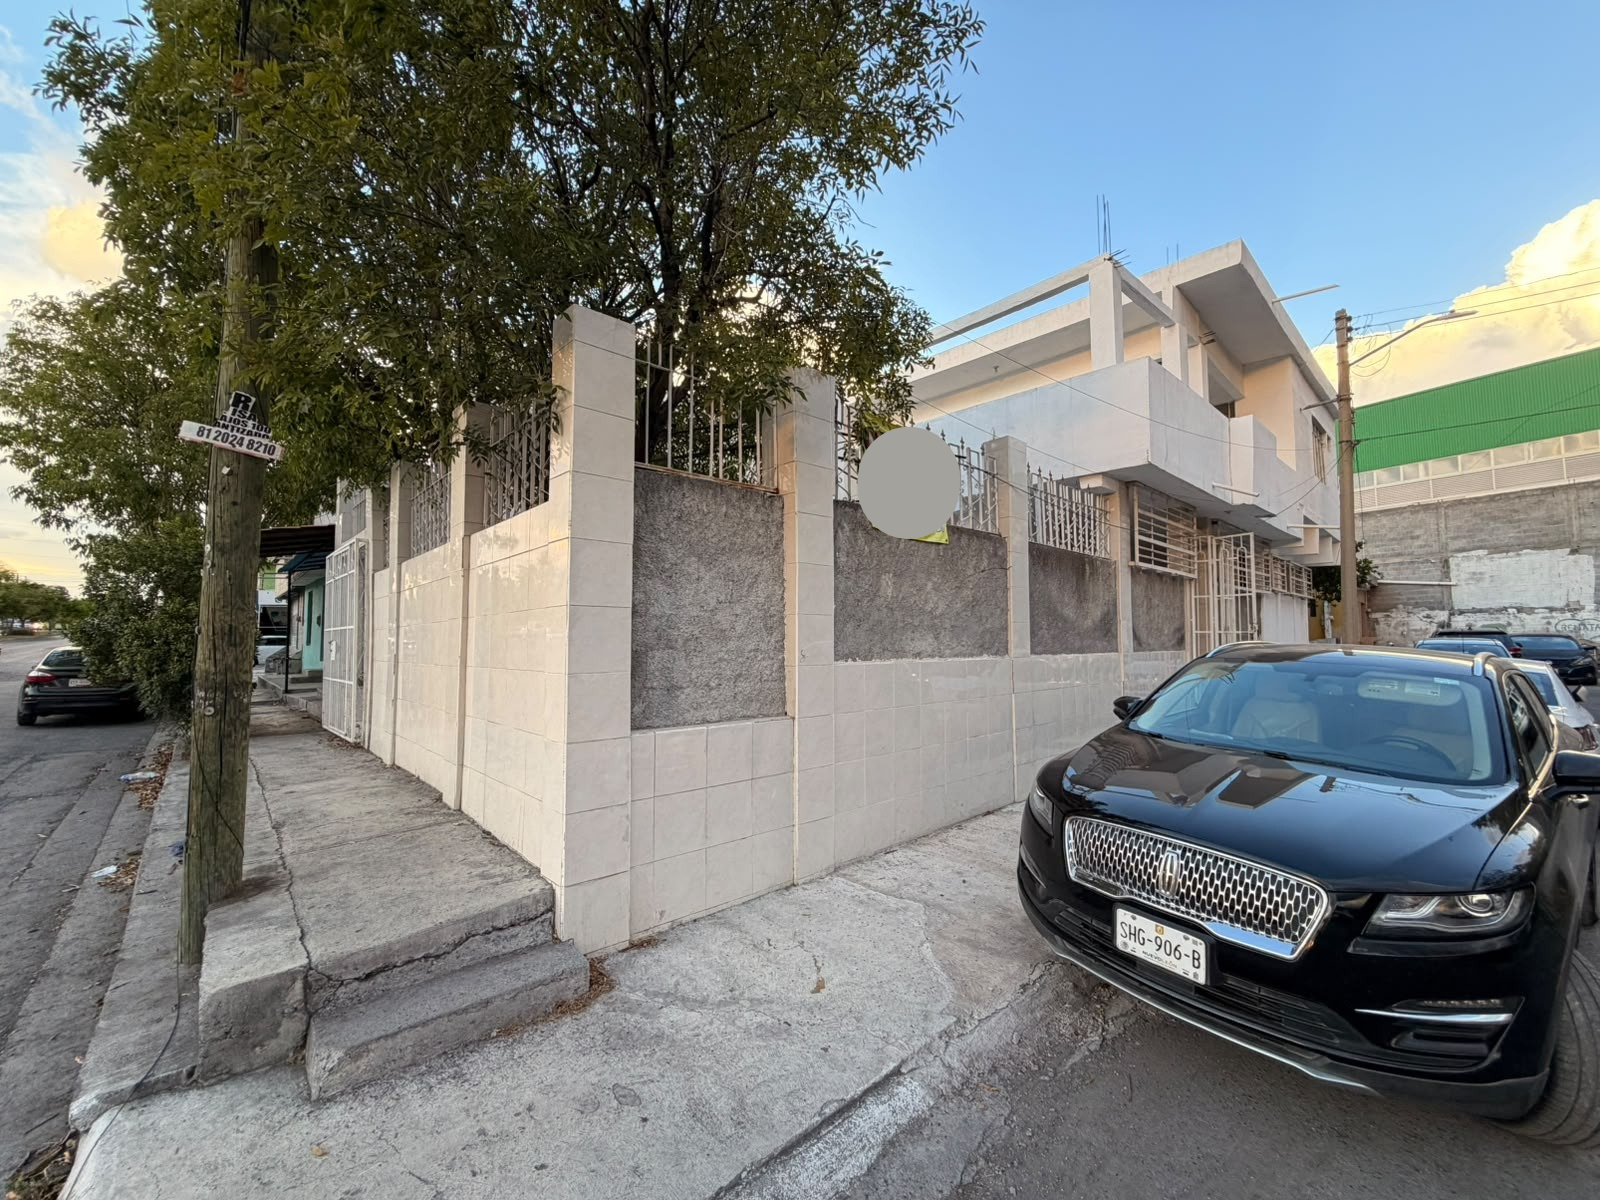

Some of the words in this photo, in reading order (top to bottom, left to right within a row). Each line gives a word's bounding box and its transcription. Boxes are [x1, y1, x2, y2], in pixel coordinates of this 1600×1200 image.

[196, 425, 212, 439] 81
[213, 431, 245, 449] 2024
[245, 438, 276, 456] 8210
[1119, 921, 1201, 969] SHG-906-B
